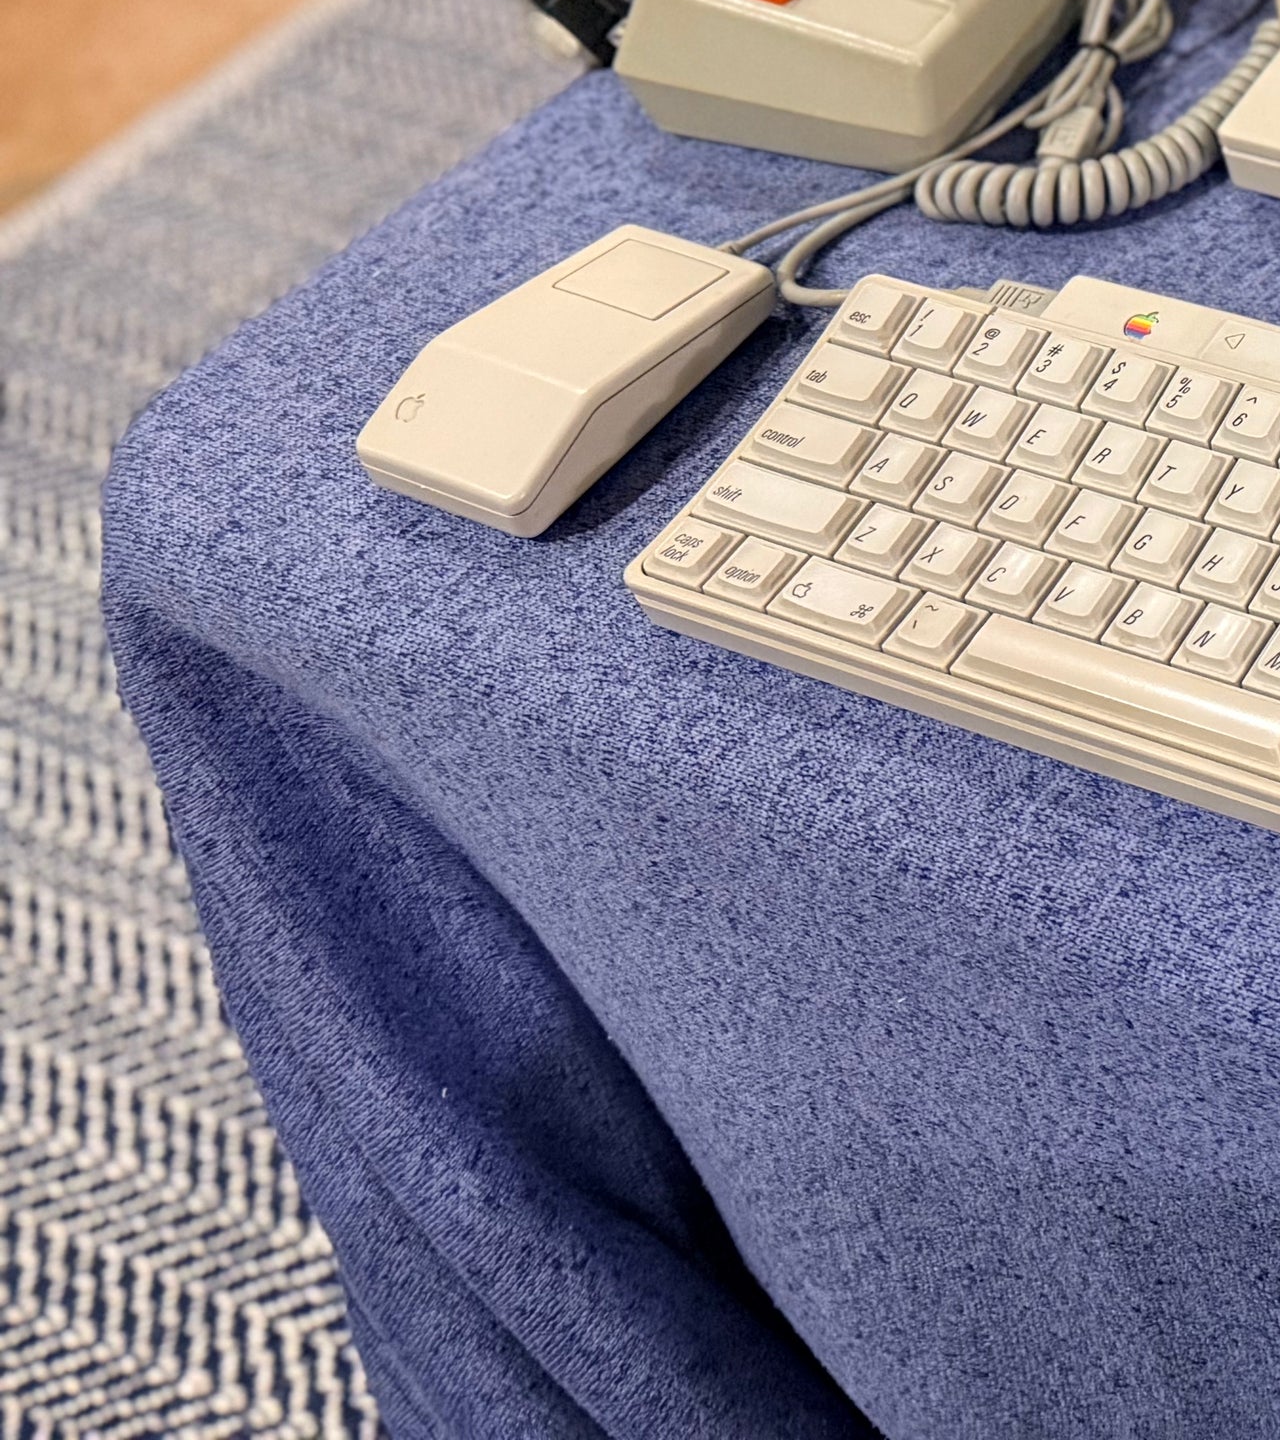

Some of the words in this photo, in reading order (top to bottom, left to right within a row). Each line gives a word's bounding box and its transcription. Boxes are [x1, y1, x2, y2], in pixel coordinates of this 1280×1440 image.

[848, 311, 872, 324] esc
[909, 323, 924, 338] 1
[983, 327, 1002, 341] @
[971, 342, 990, 356] 2
[1047, 344, 1064, 358] #
[1035, 358, 1053, 373] 3
[805, 369, 828, 384] tab
[1103, 378, 1119, 392] 4
[1178, 376, 1193, 395] %
[1165, 394, 1183, 409] 5
[961, 409, 987, 428] W
[1231, 412, 1248, 427] 6
[760, 428, 806, 448] control
[1026, 428, 1047, 445] E
[1091, 447, 1112, 464] R
[868, 457, 890, 473] A
[1157, 465, 1177, 481] T
[933, 475, 954, 492] S
[712, 485, 743, 502] shift
[1224, 484, 1245, 501] Y
[998, 494, 1020, 511] D
[1064, 515, 1086, 530] F
[674, 533, 704, 549] caps
[854, 526, 877, 543] Z
[1132, 534, 1153, 551] G
[659, 544, 690, 562] lock
[919, 546, 944, 564] X
[1201, 554, 1224, 572] H
[724, 563, 761, 584] option
[986, 567, 1007, 583] C
[1053, 586, 1075, 603] V
[1122, 608, 1144, 626] B
[1192, 630, 1216, 648] N
